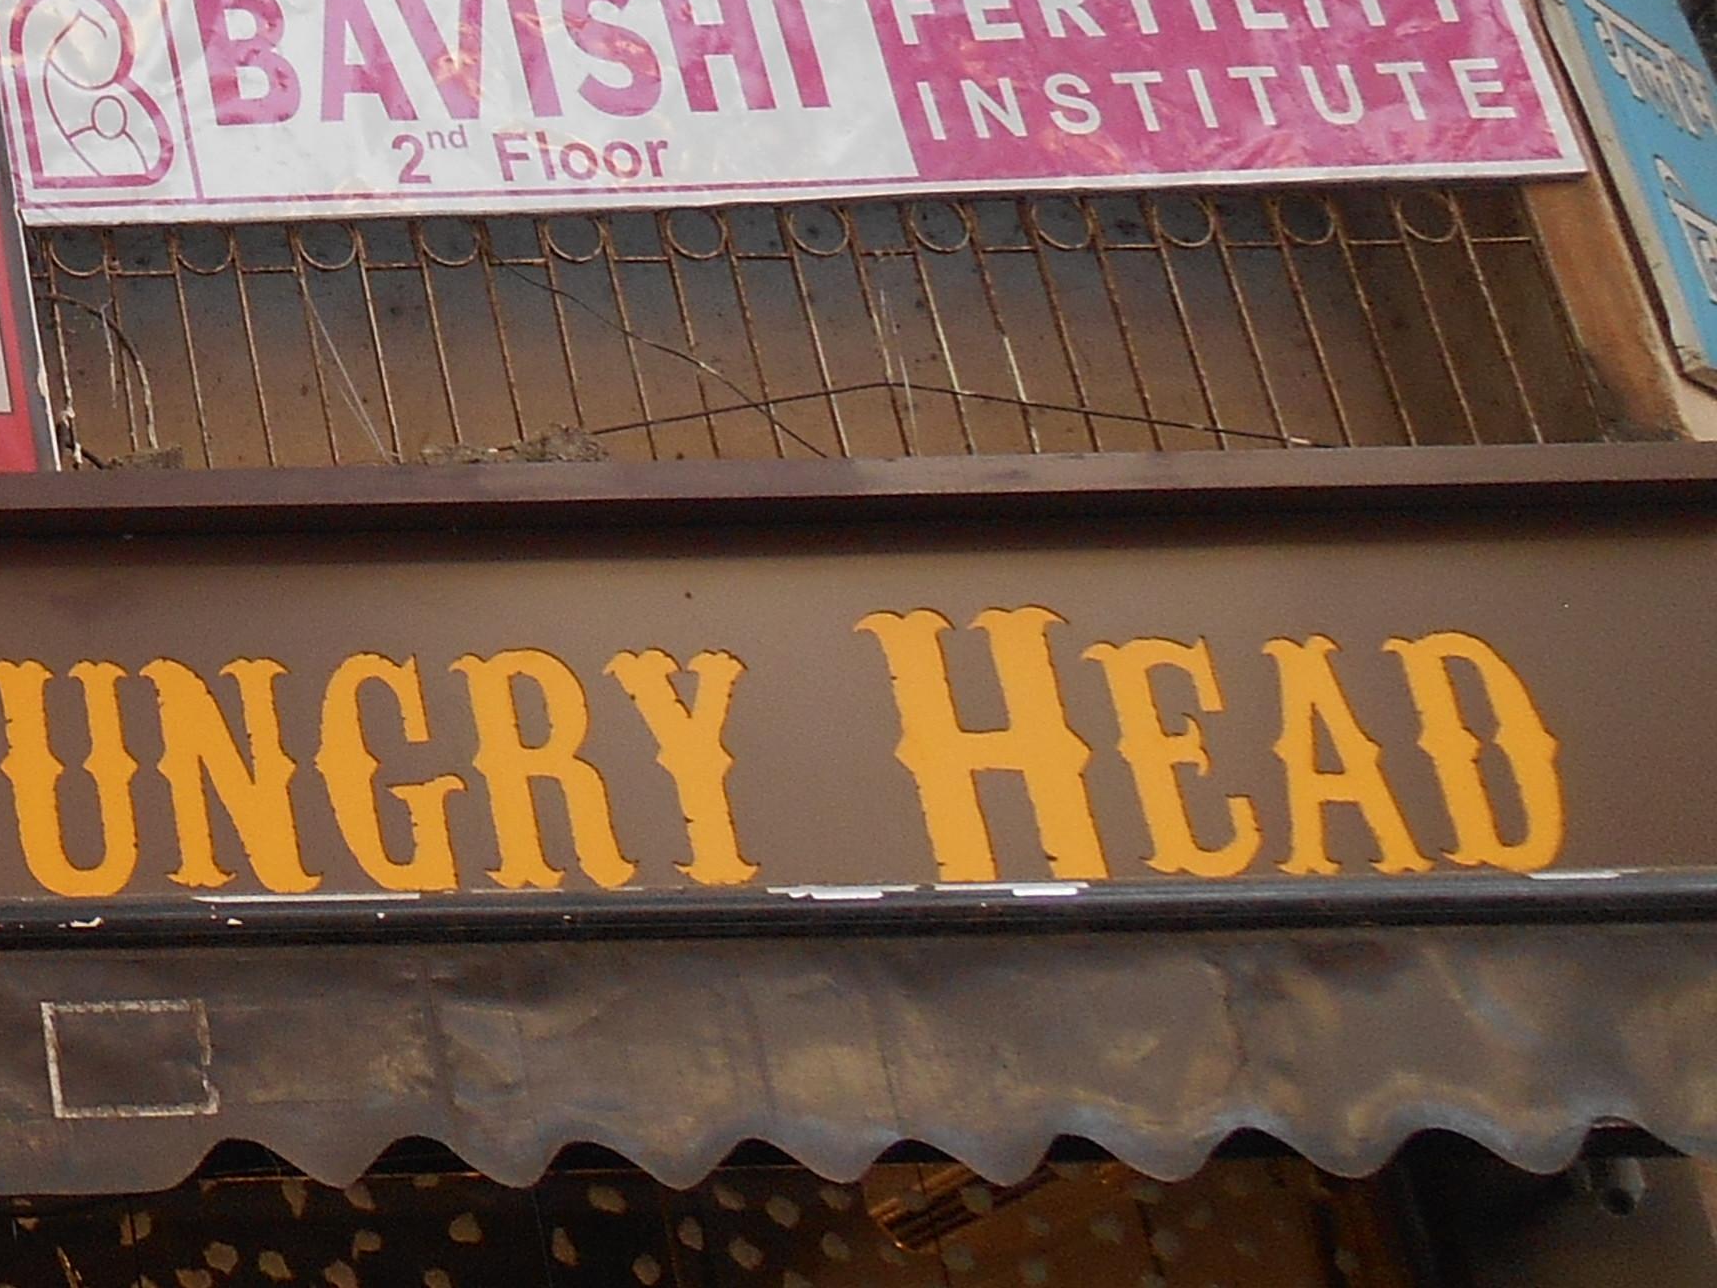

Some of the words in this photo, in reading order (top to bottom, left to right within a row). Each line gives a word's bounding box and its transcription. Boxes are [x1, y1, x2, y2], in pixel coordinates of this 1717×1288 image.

[920, 56, 1517, 143] INSTITUTE
[391, 128, 467, 185] 2nd
[493, 133, 670, 184] Floor
[857, 606, 1565, 884] HEAD
